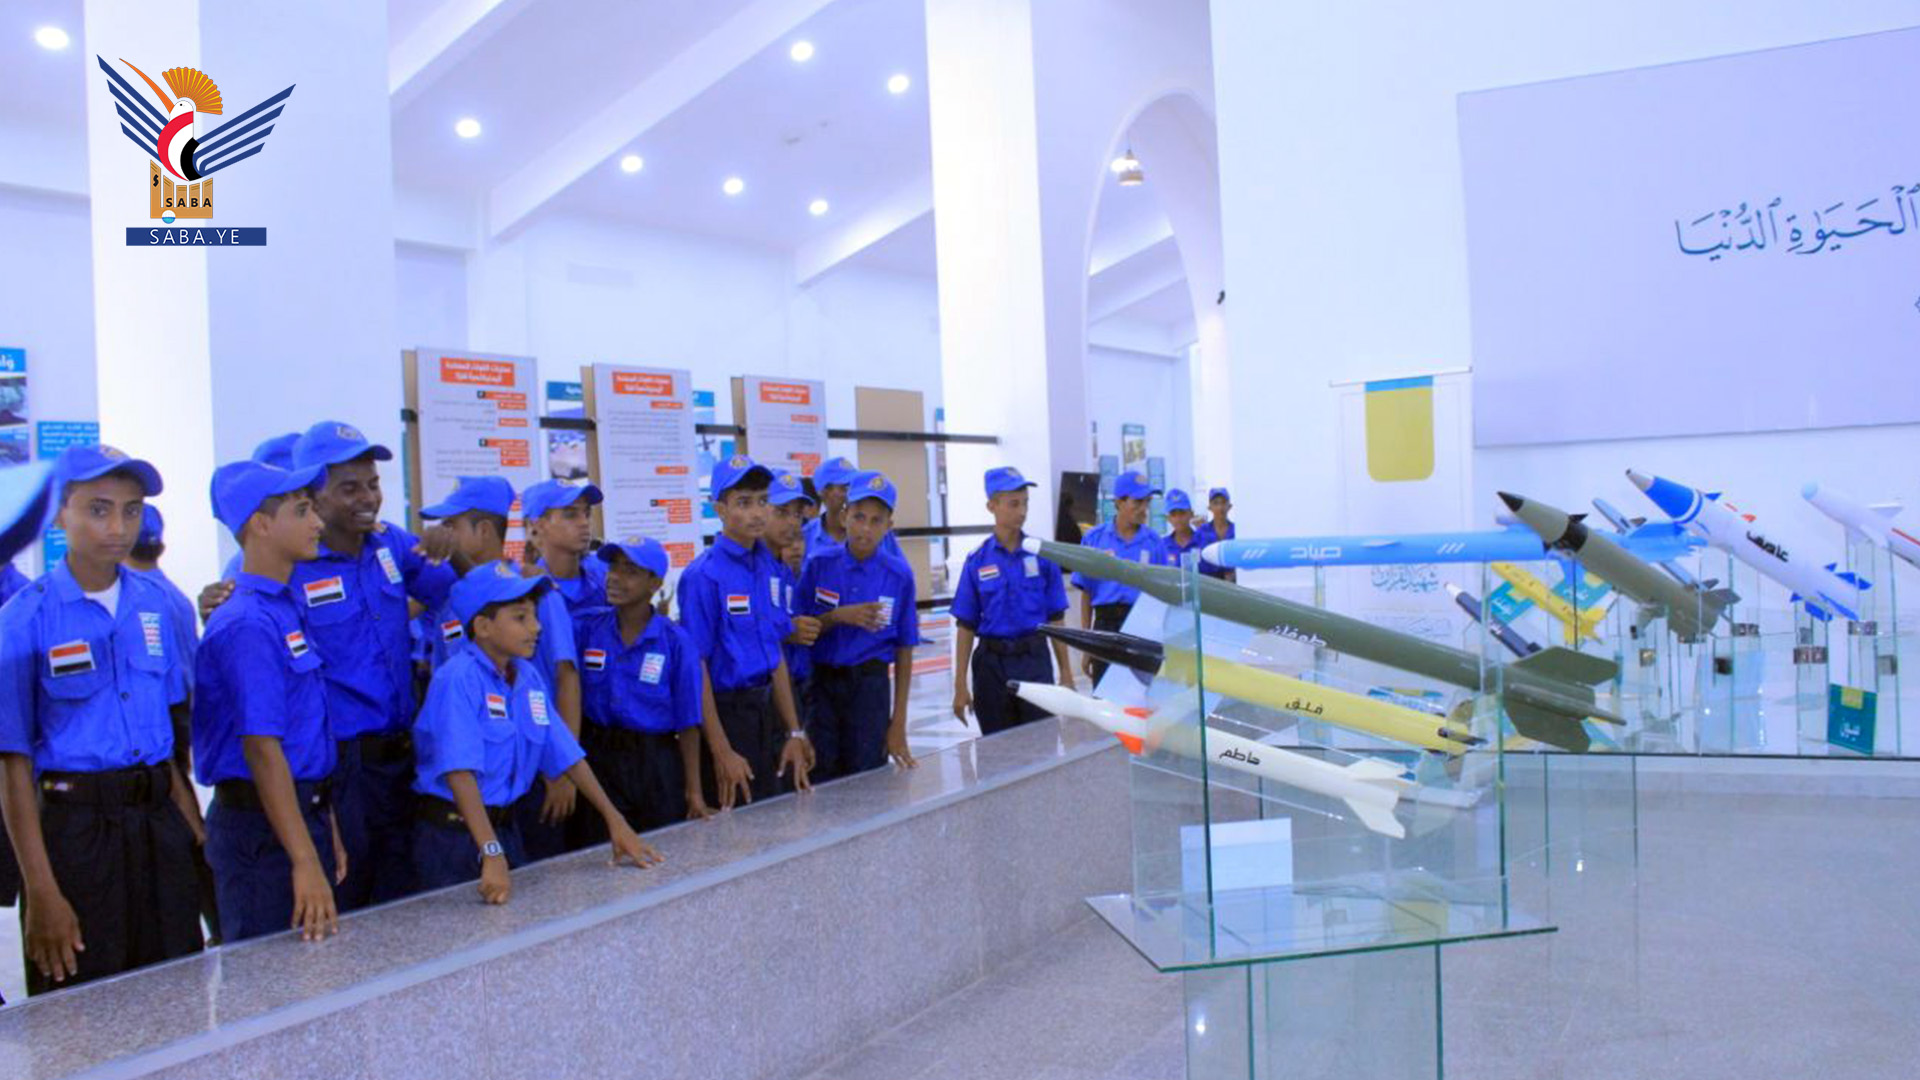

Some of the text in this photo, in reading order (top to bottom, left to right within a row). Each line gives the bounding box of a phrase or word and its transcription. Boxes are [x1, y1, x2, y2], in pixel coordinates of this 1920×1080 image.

[1267, 623, 1328, 647] طوفان
[1285, 698, 1324, 715] فلق
[1219, 747, 1261, 766] حاطم
